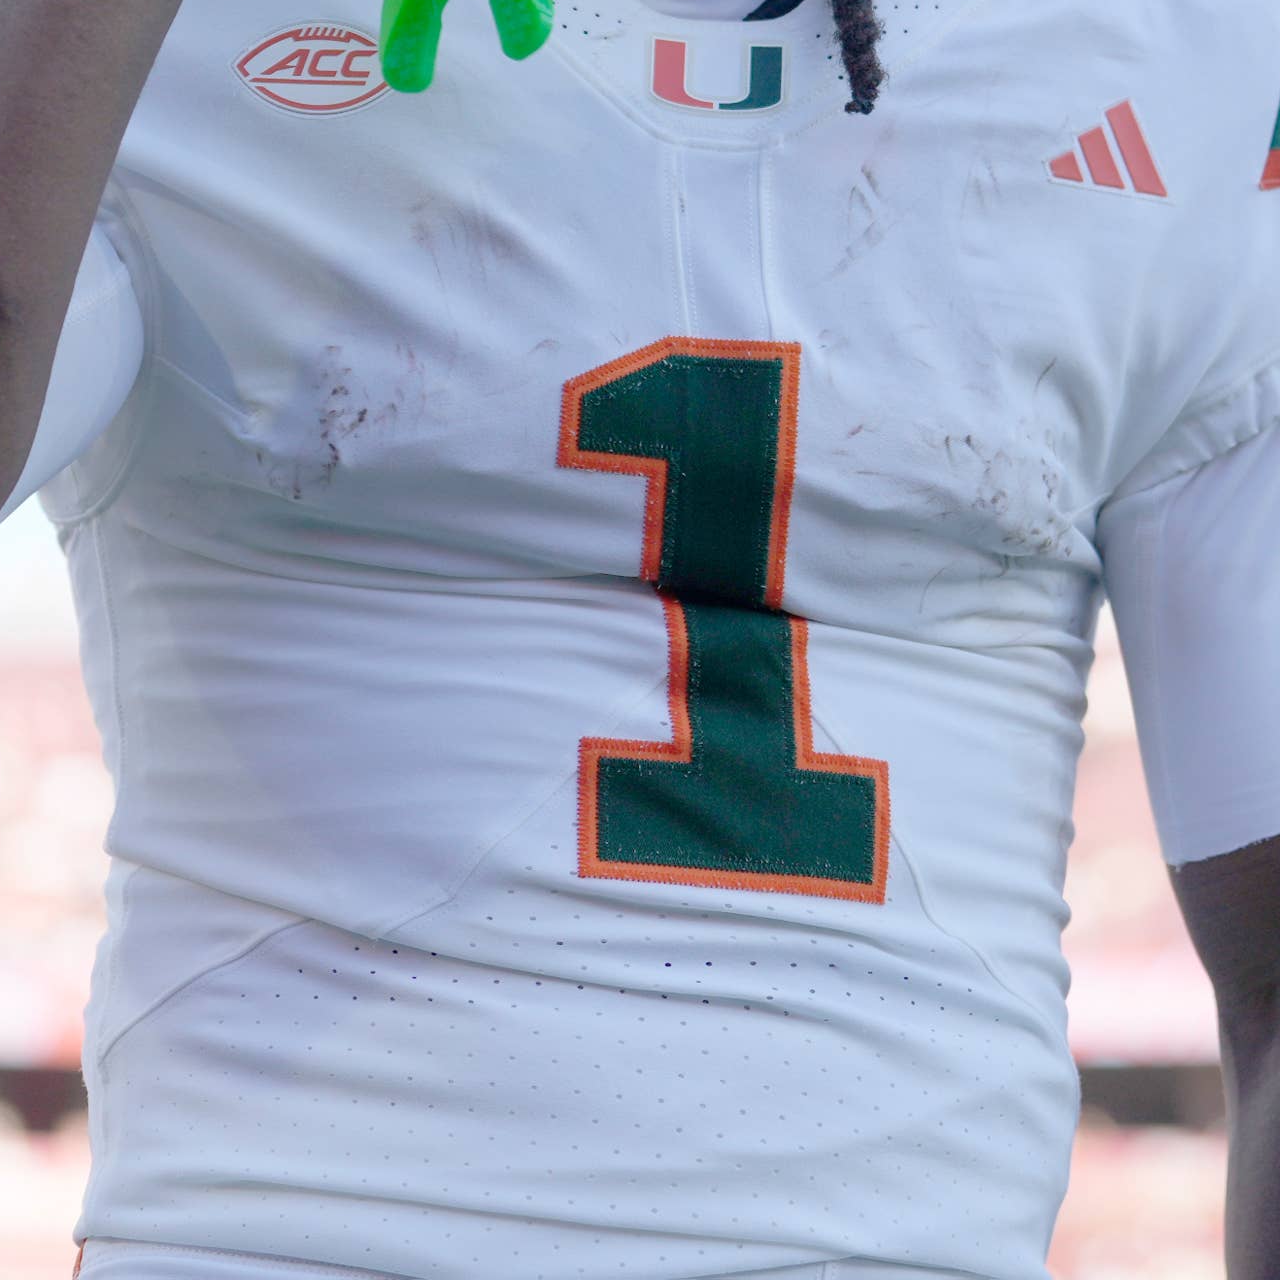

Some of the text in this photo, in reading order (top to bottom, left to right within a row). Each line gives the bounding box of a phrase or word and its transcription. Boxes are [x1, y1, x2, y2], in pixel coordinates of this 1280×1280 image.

[260, 49, 378, 79] ACC
[651, 37, 783, 110] U
[557, 335, 890, 904] 1
